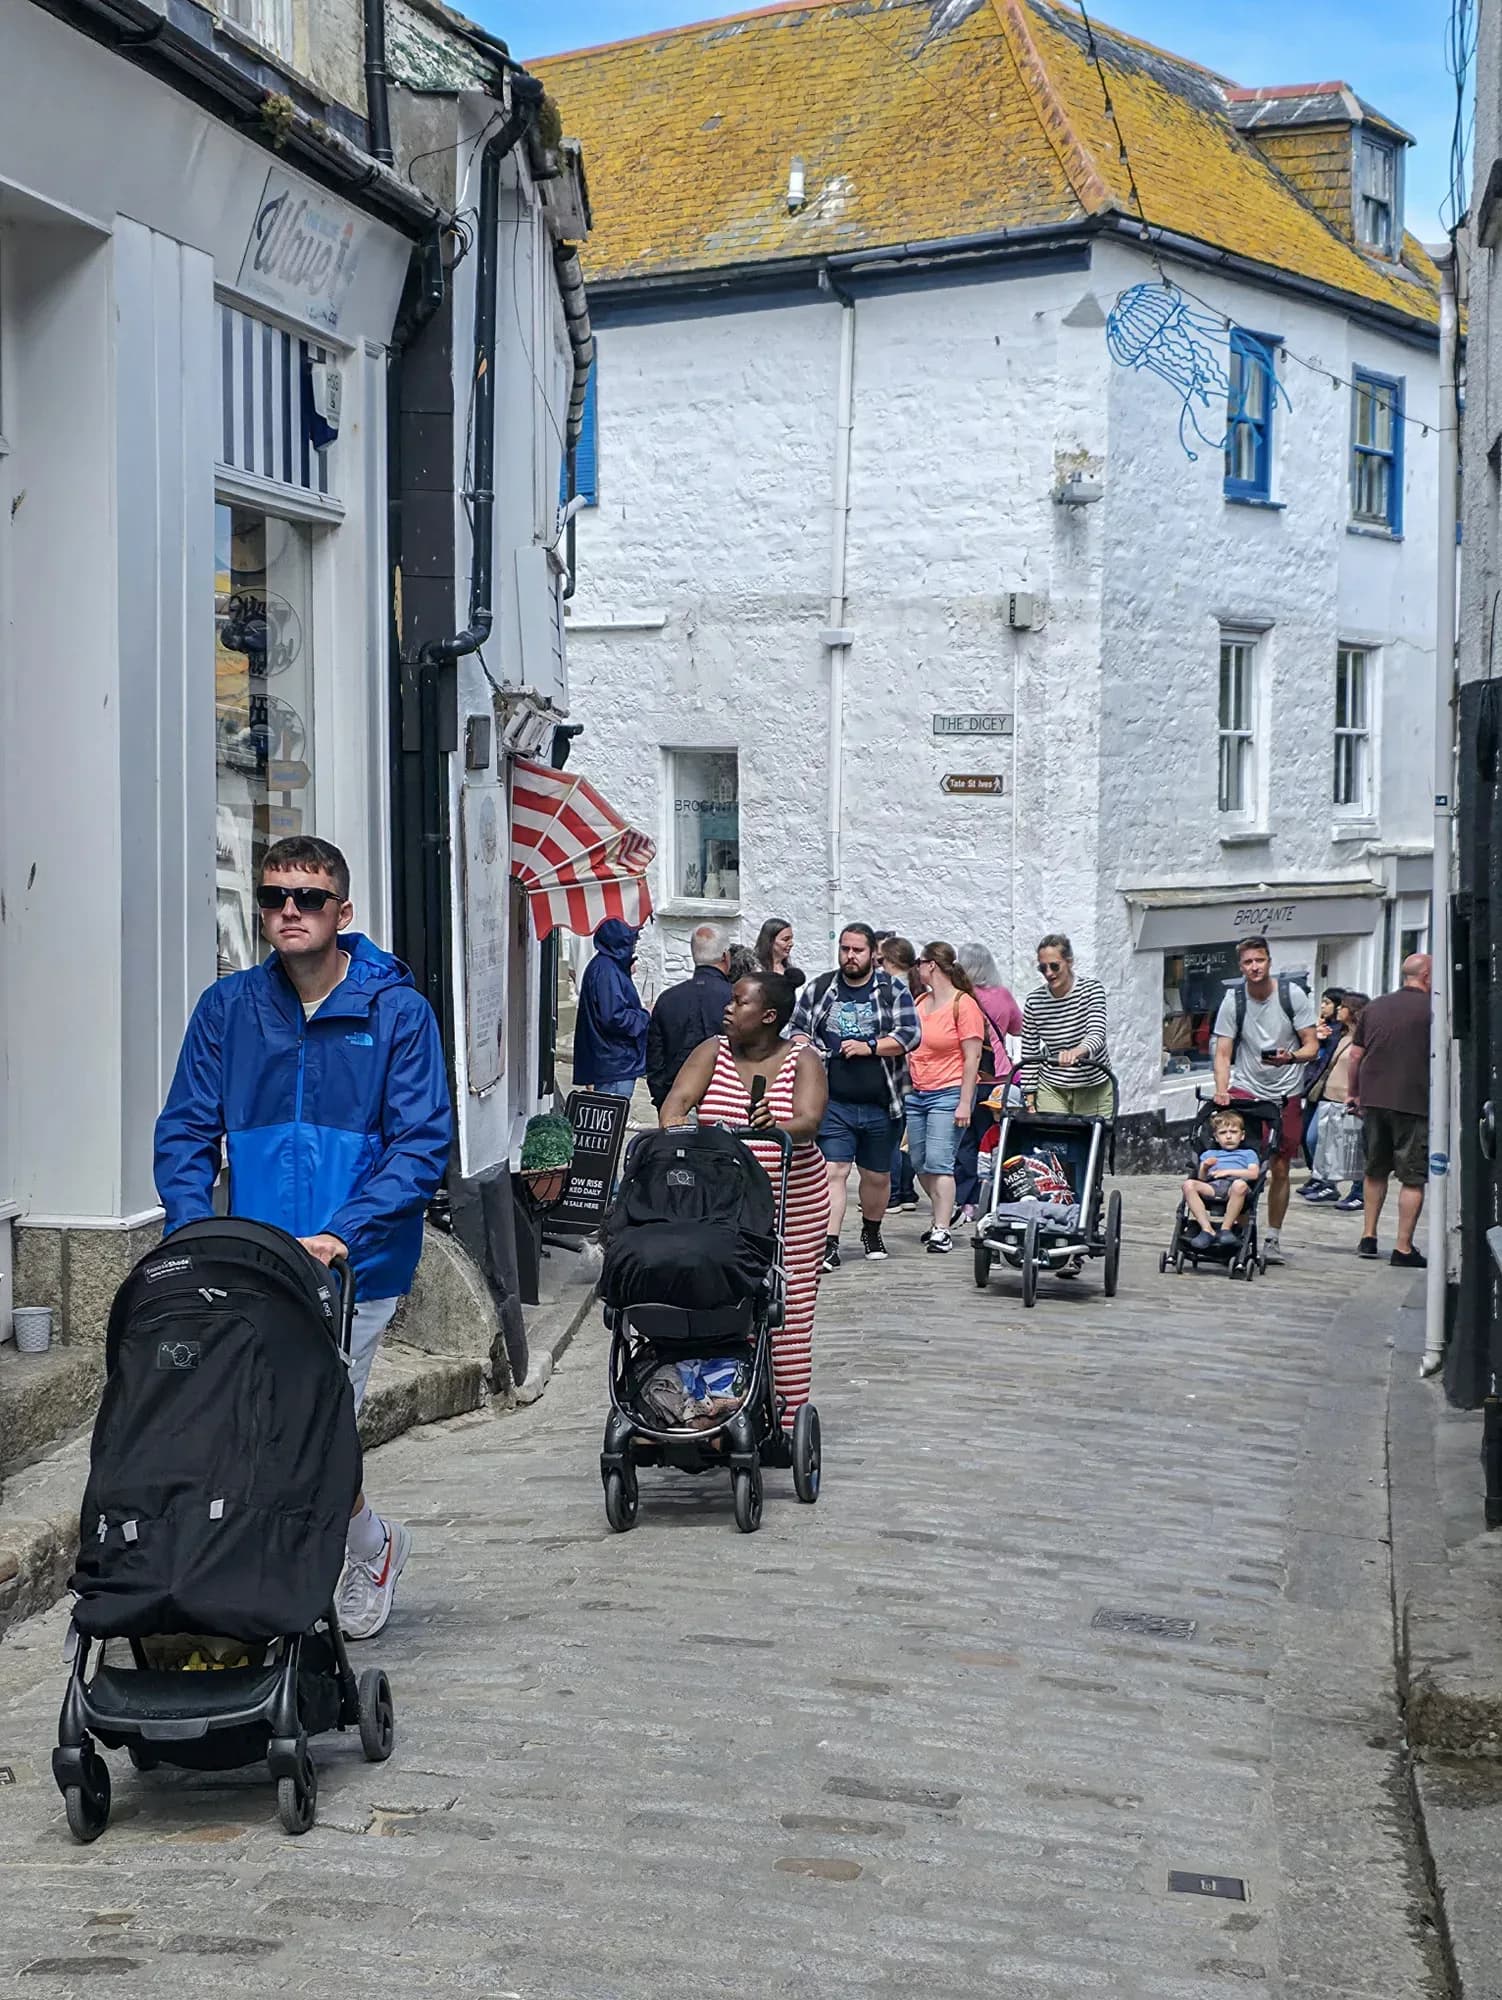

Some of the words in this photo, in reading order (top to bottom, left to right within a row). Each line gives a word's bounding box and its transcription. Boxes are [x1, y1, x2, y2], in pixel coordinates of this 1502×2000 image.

[940, 717, 962, 730] THE
[950, 779, 965, 788] Tate
[967, 779, 976, 788] St
[978, 779, 993, 788] Ives
[1233, 905, 1297, 926] BROCANTE
[1184, 952, 1227, 967] BROCANTE
[576, 1106, 589, 1129] ST
[589, 1108, 614, 1132] IVES
[571, 1177, 585, 1187] OW
[586, 1179, 604, 1189] RISE
[1003, 1168, 1026, 1186] M&S
